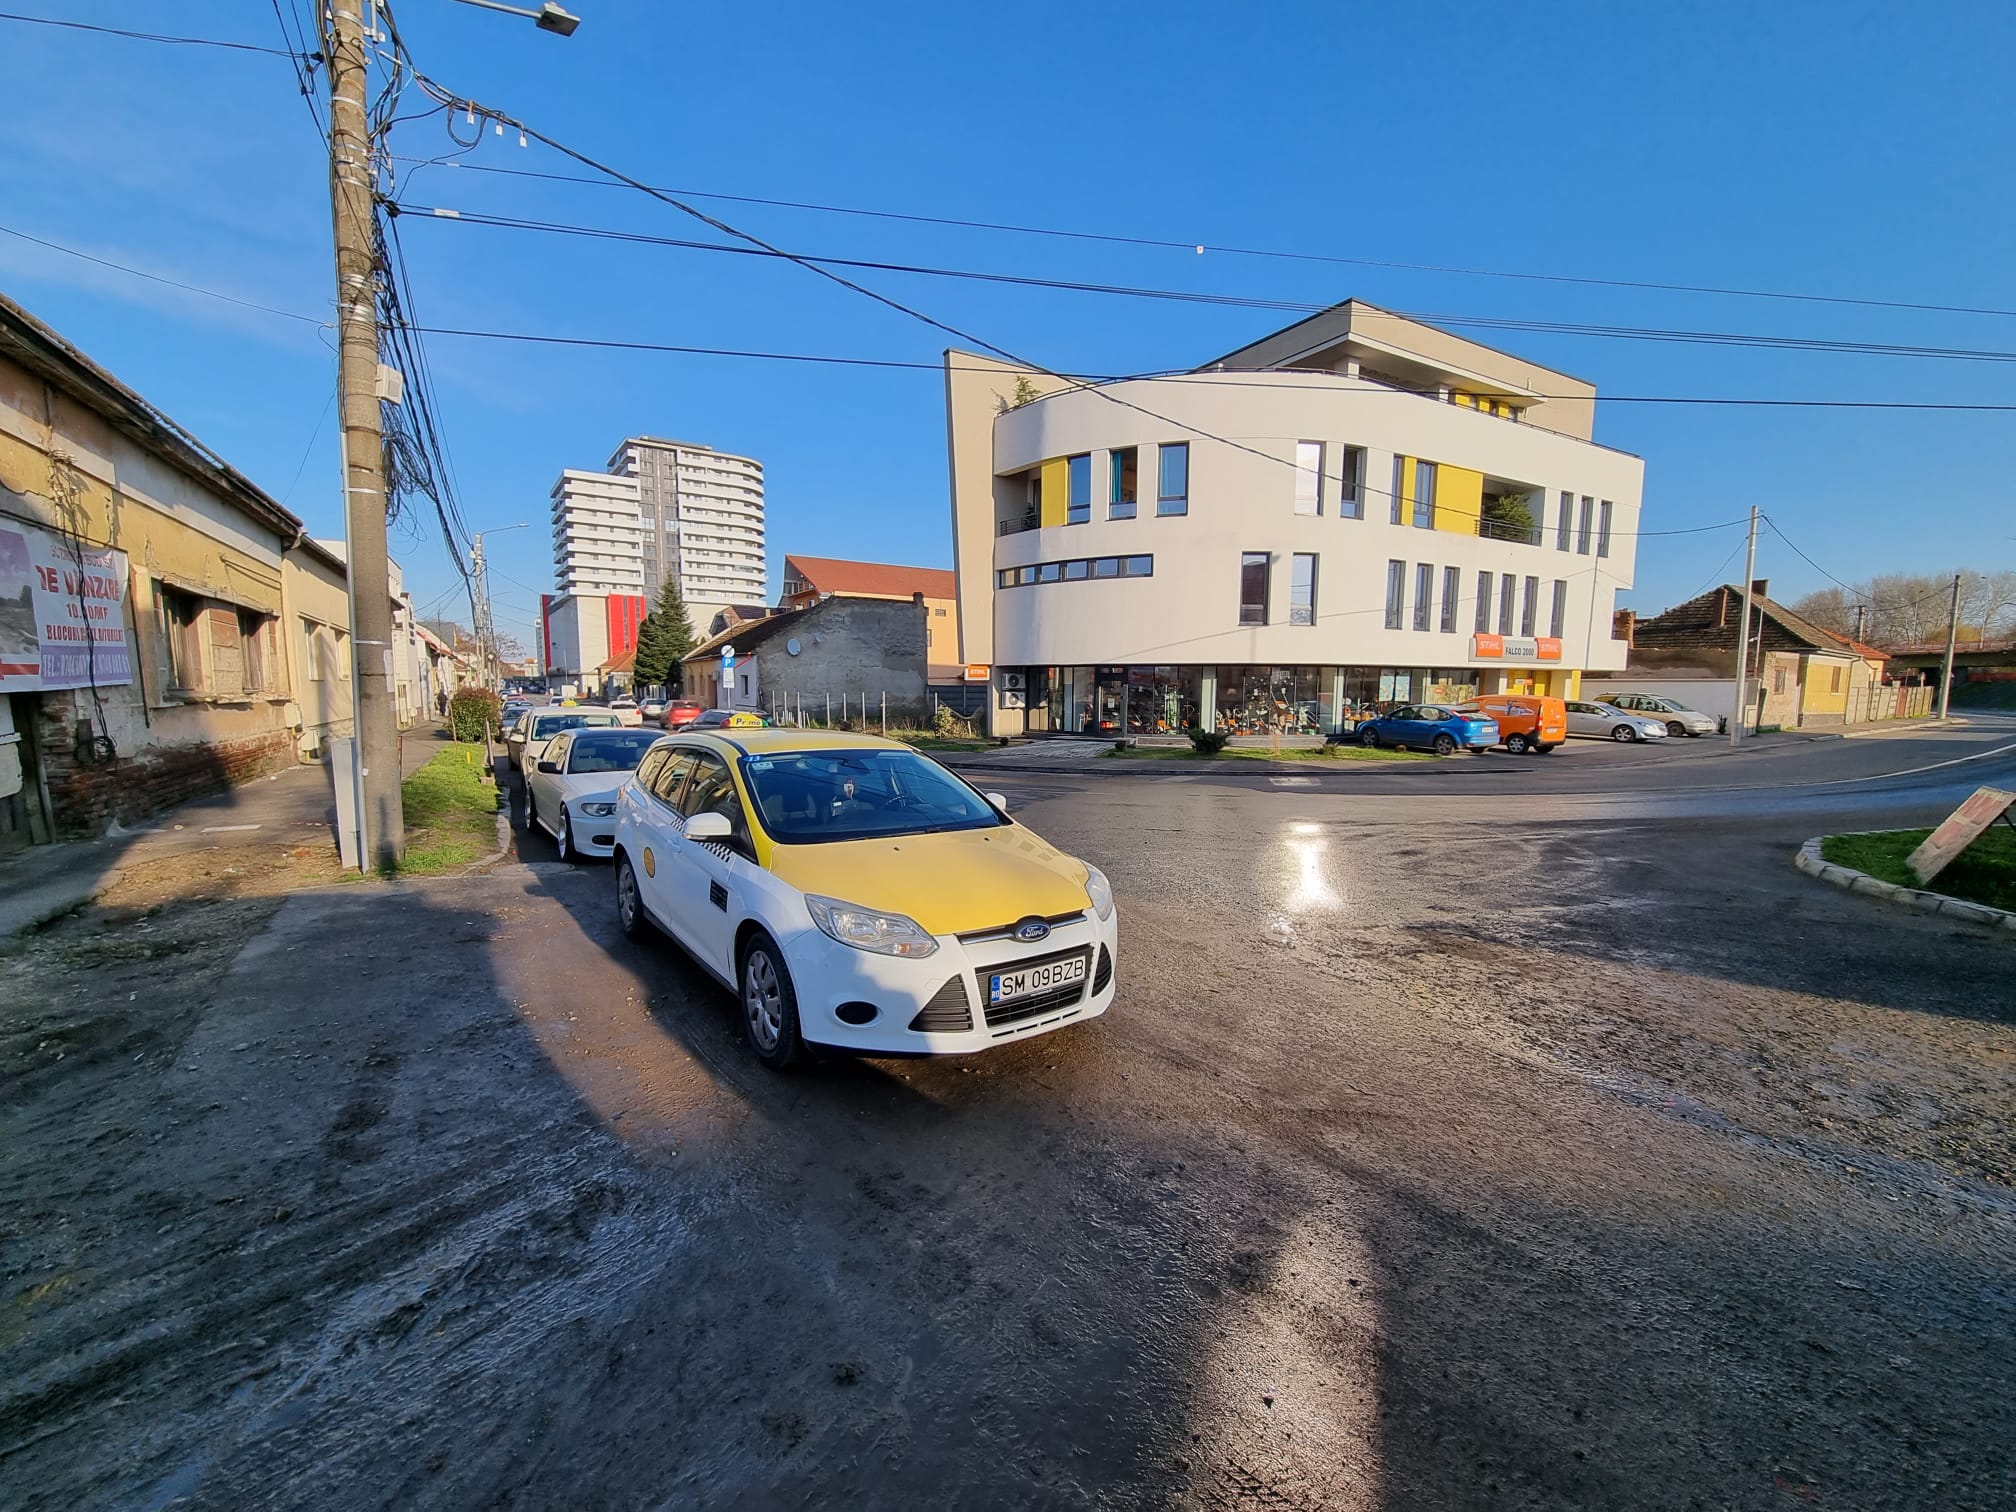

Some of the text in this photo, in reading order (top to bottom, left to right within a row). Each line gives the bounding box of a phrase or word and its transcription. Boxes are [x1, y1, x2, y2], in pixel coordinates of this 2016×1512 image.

[1480, 641, 1501, 650] STIHL
[1541, 643, 1559, 653] STIHL
[1505, 646, 1535, 657] FALCO 2000
[1025, 926, 1044, 937] Ford
[1002, 973, 1025, 996] SM
